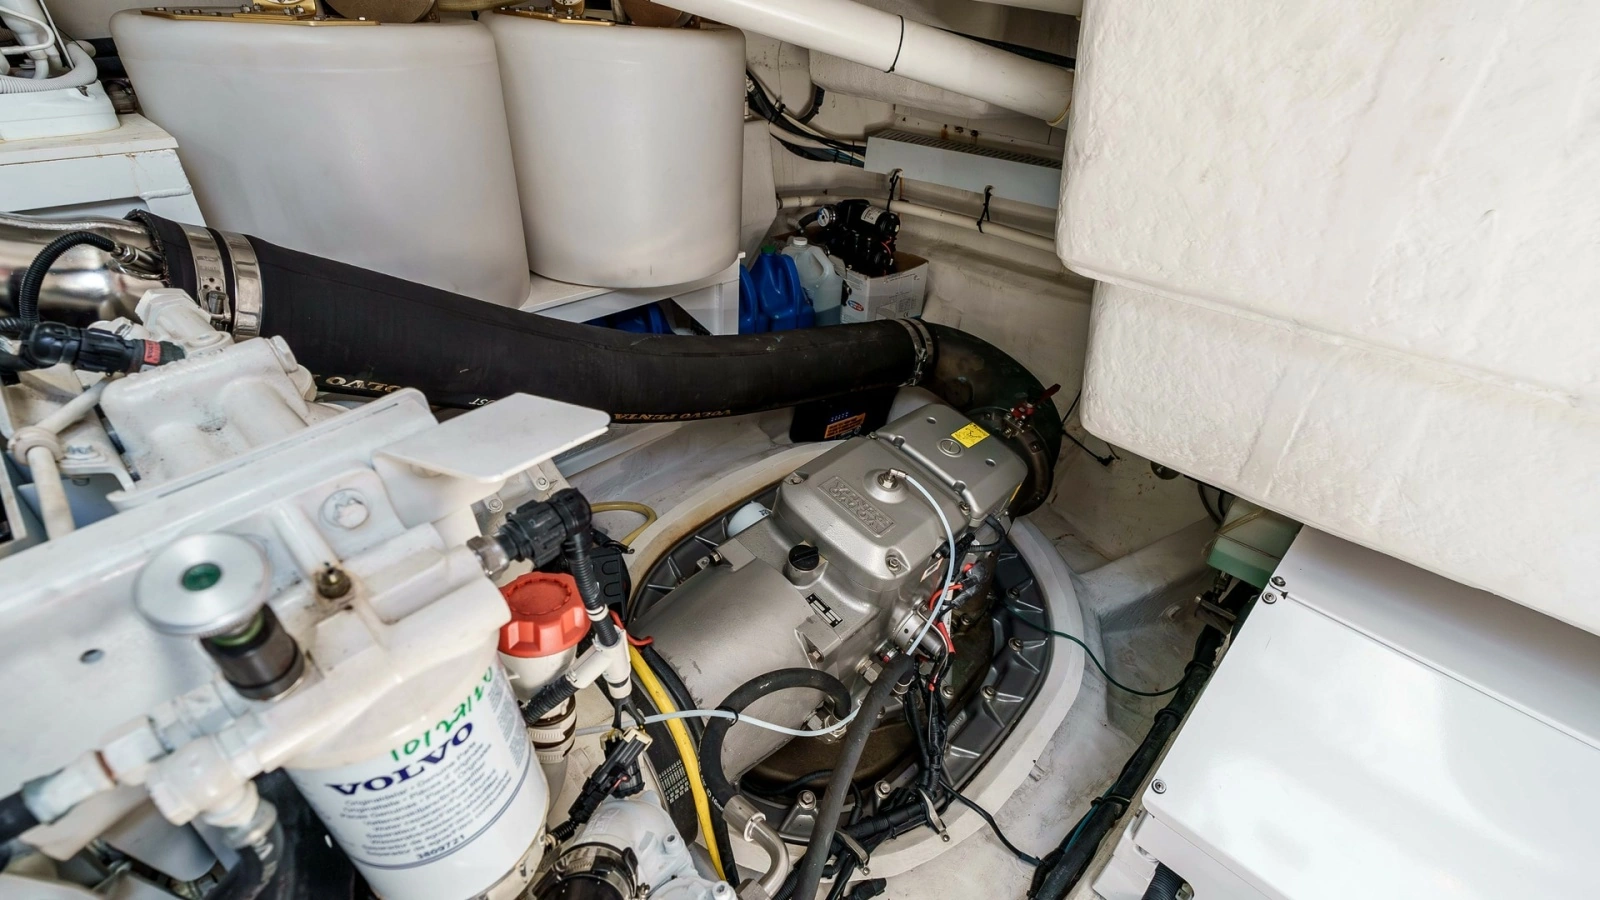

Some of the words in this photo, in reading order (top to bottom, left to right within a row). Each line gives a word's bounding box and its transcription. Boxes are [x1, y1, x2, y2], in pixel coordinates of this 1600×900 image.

[325, 376, 402, 393] OLVO
[680, 409, 731, 419] VOLVO
[324, 722, 473, 795] VOLVO
